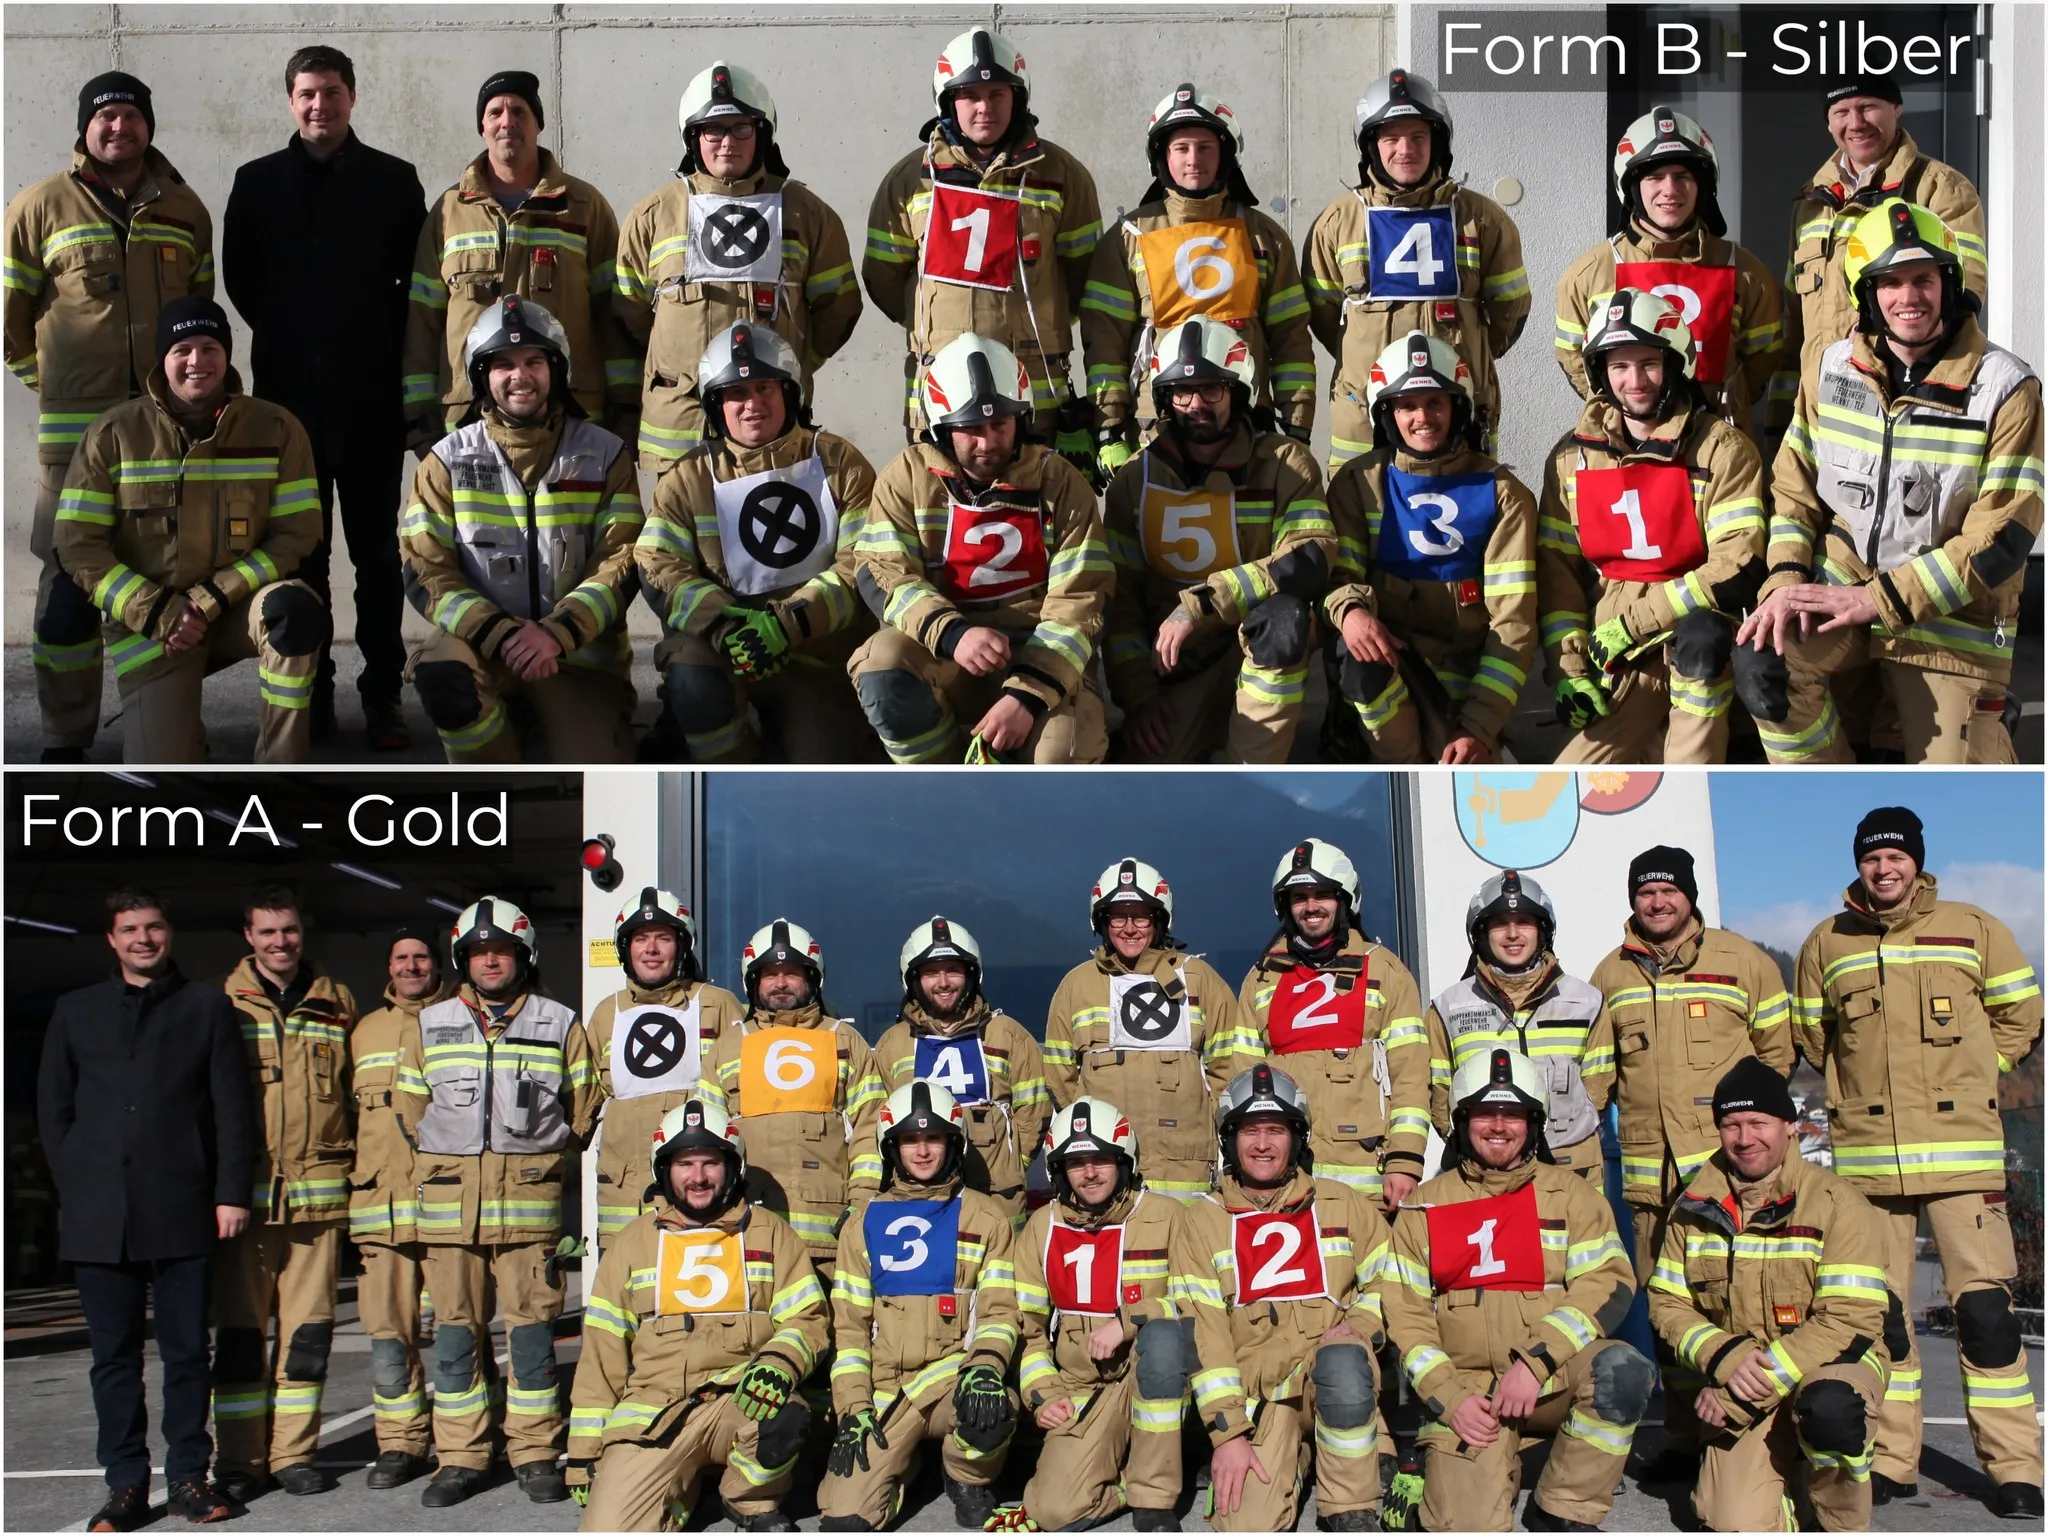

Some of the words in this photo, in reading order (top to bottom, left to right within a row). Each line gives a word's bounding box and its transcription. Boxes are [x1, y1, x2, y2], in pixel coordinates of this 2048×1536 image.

[93, 91, 135, 106] FEUERWEHR
[952, 208, 990, 273] 1
[1173, 236, 1234, 300] 6
[1384, 222, 1444, 286] 4
[172, 319, 219, 332] FEUERWEHR
[1161, 503, 1216, 573] 5
[1408, 493, 1464, 556] 3
[1611, 489, 1662, 560] 1
[963, 522, 1030, 588] 2
[1863, 832, 1905, 844] FEUERWEHR
[1638, 871, 1675, 883] FEUERWEHR
[1292, 972, 1339, 1030] 2
[764, 1039, 816, 1091] 6
[926, 1047, 975, 1095] 4
[1721, 1100, 1755, 1110] FEUERWEHR
[880, 1216, 932, 1272] 3
[1063, 1243, 1095, 1304] 1
[1250, 1221, 1306, 1291] 2
[1468, 1218, 1506, 1278] 1
[673, 1244, 730, 1308] 5
